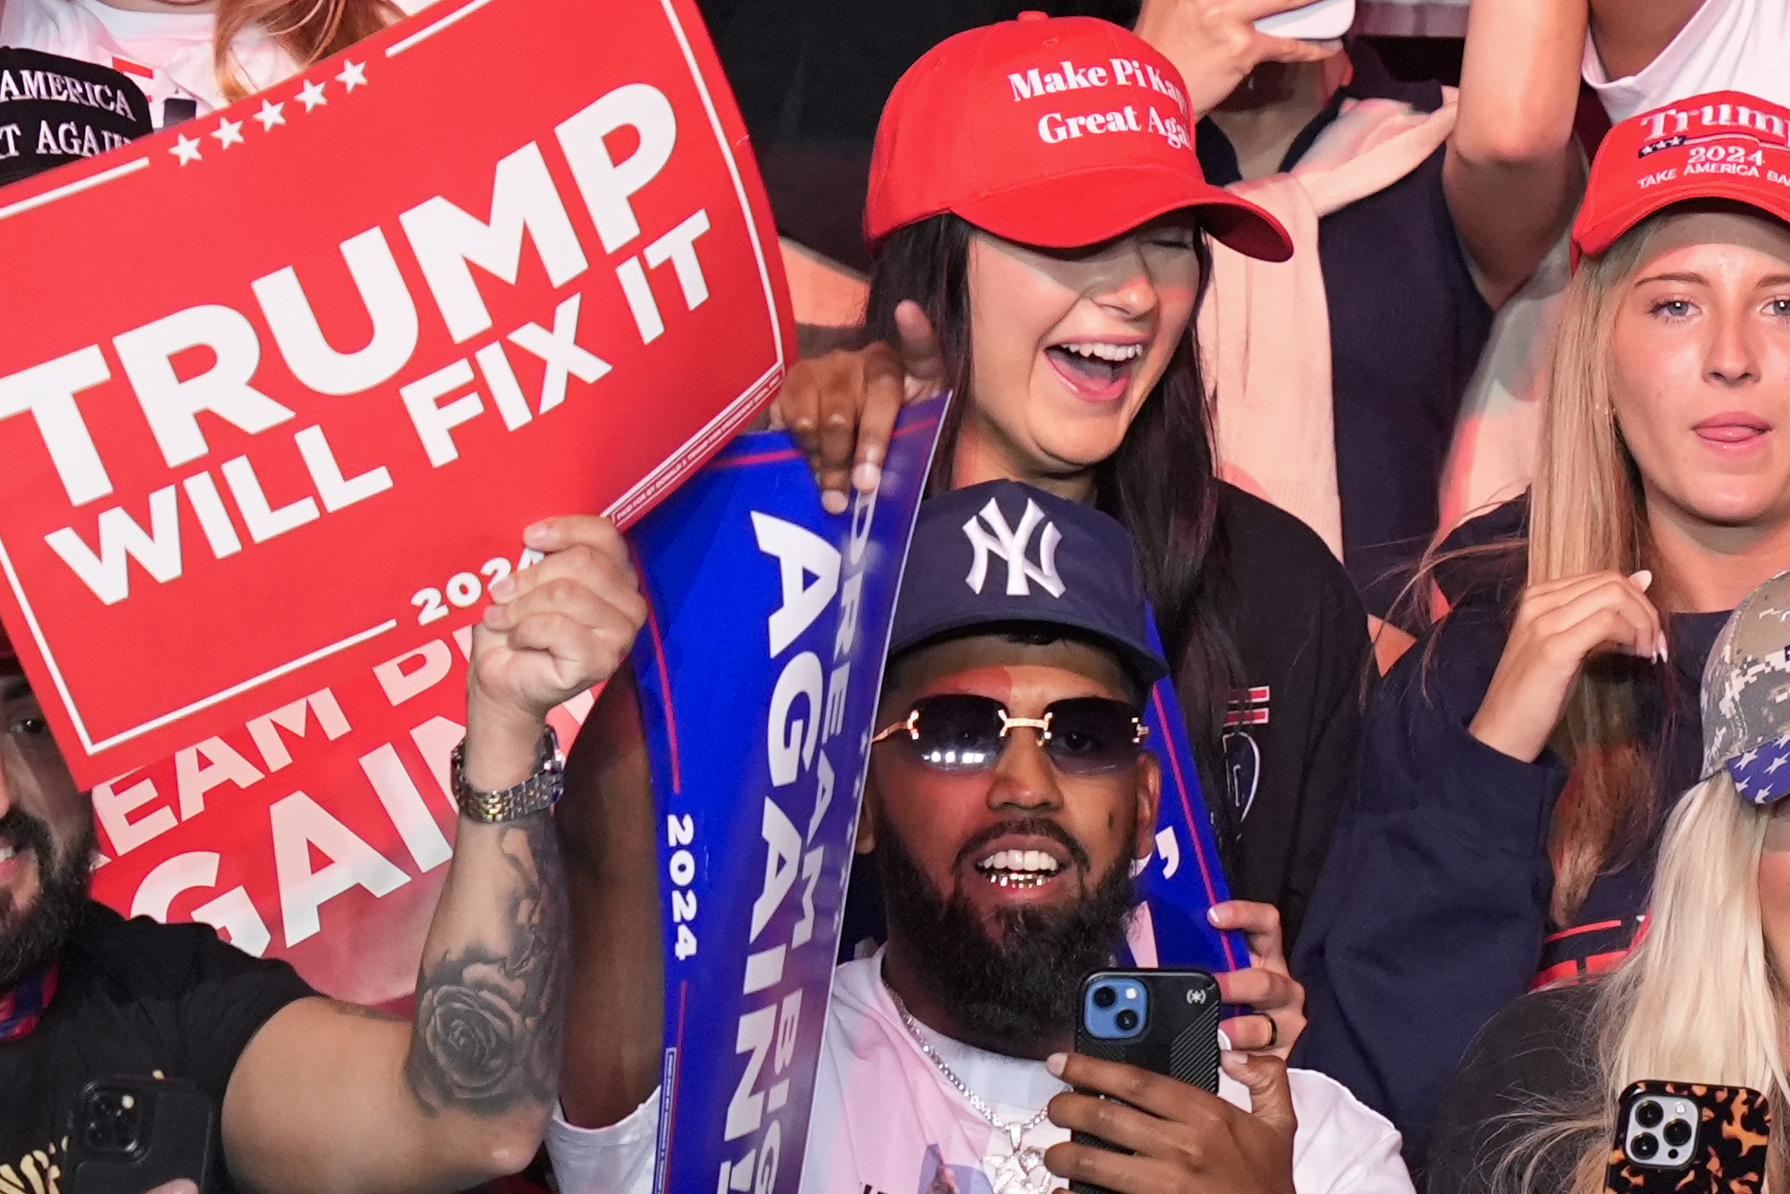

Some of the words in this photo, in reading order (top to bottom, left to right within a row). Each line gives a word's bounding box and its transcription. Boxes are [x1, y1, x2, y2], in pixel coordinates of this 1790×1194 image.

[0, 69, 137, 123] AMERICA
[1008, 61, 1108, 102] Make
[1109, 58, 1148, 88] Pi
[1038, 105, 1142, 144] Great
[1637, 168, 1678, 189] TAKE
[1683, 163, 1760, 178] AMERICA
[1687, 145, 1766, 166] 2024
[0, 83, 677, 506] TRUMP
[44, 424, 393, 606] WILL
[399, 292, 613, 468] FIX
[615, 208, 711, 345] IT
[961, 496, 1068, 599] NY
[91, 688, 352, 869] EAM
[130, 715, 465, 958] GAI
[666, 813, 699, 962] 2024
